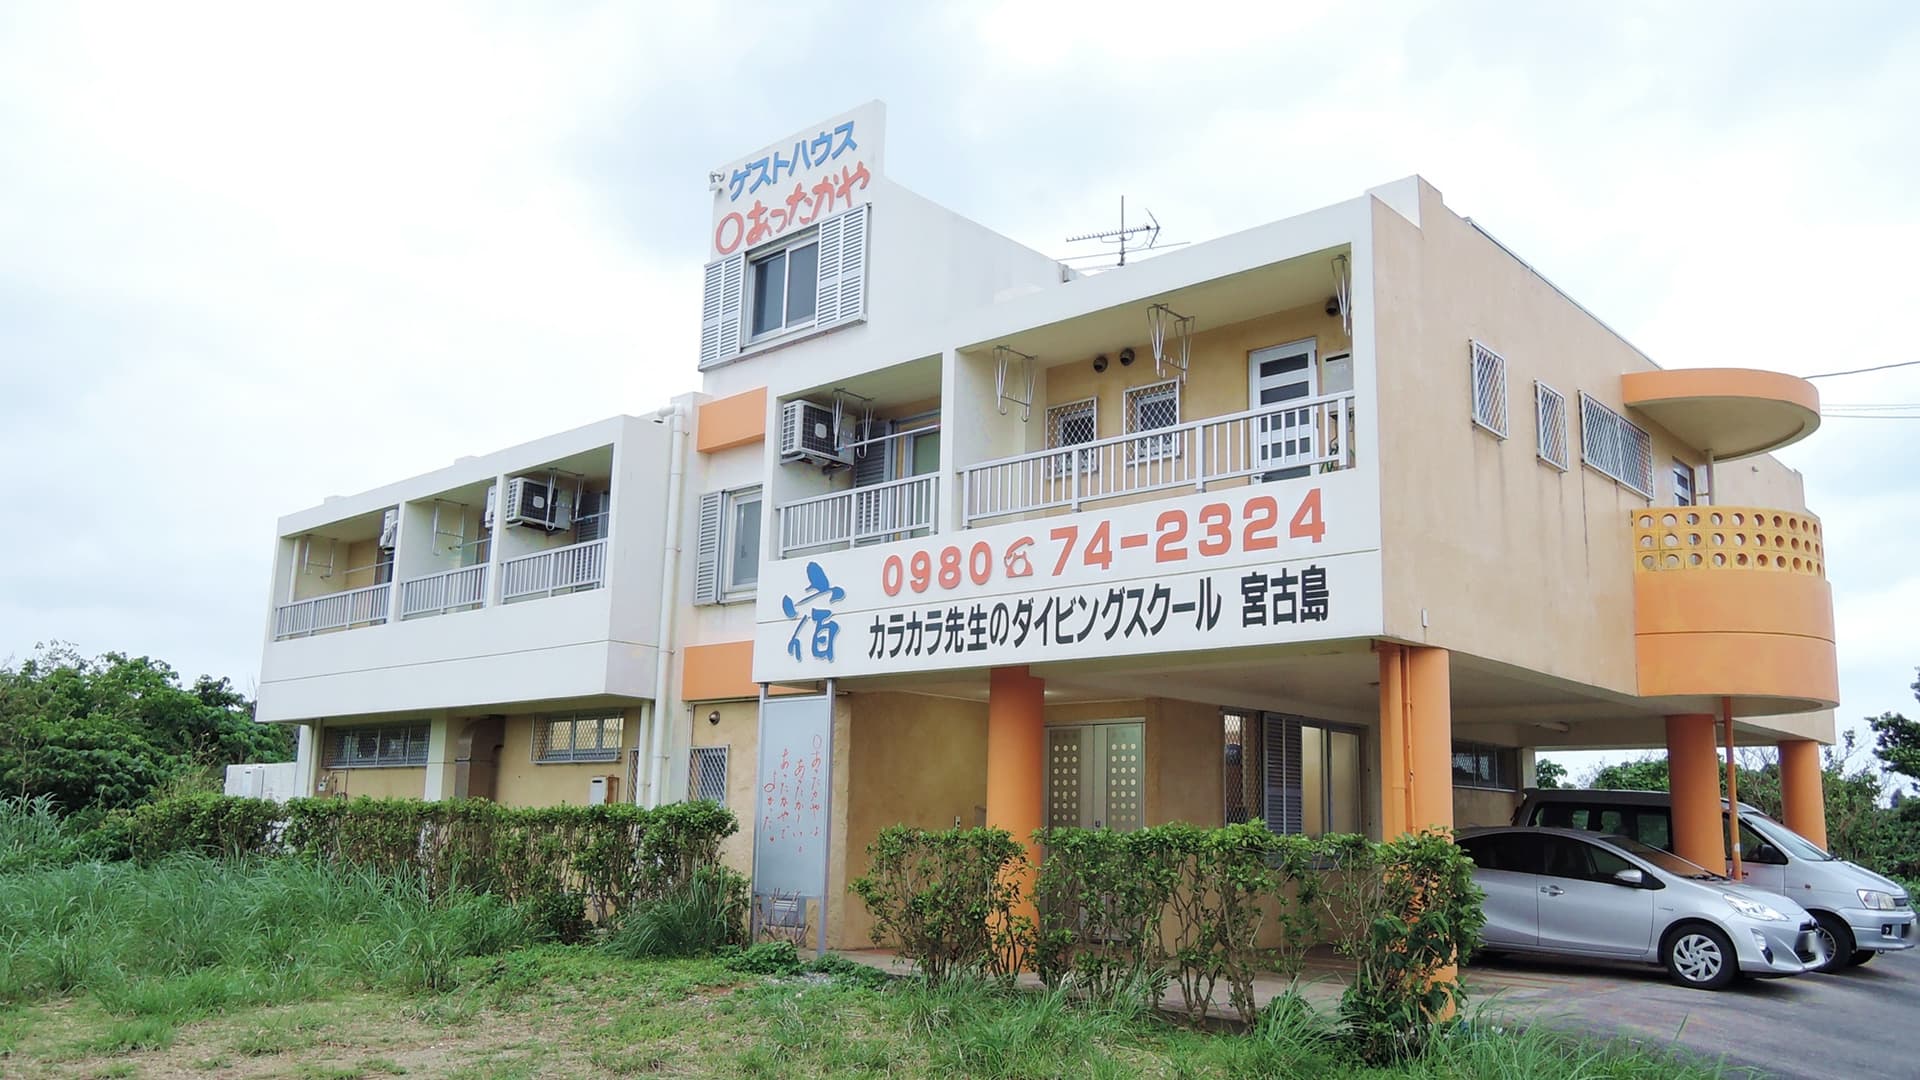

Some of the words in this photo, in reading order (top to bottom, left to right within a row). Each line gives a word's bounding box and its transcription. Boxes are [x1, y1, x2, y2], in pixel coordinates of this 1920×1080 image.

[729, 120, 858, 202] ゲストハウス
[882, 541, 993, 596] 0980
[1050, 488, 1327, 577] 74-2324
[782, 561, 847, 663] 宿
[868, 577, 1222, 660] カラカラ先生のダイビングスクール
[1240, 564, 1329, 629] 宮古島
